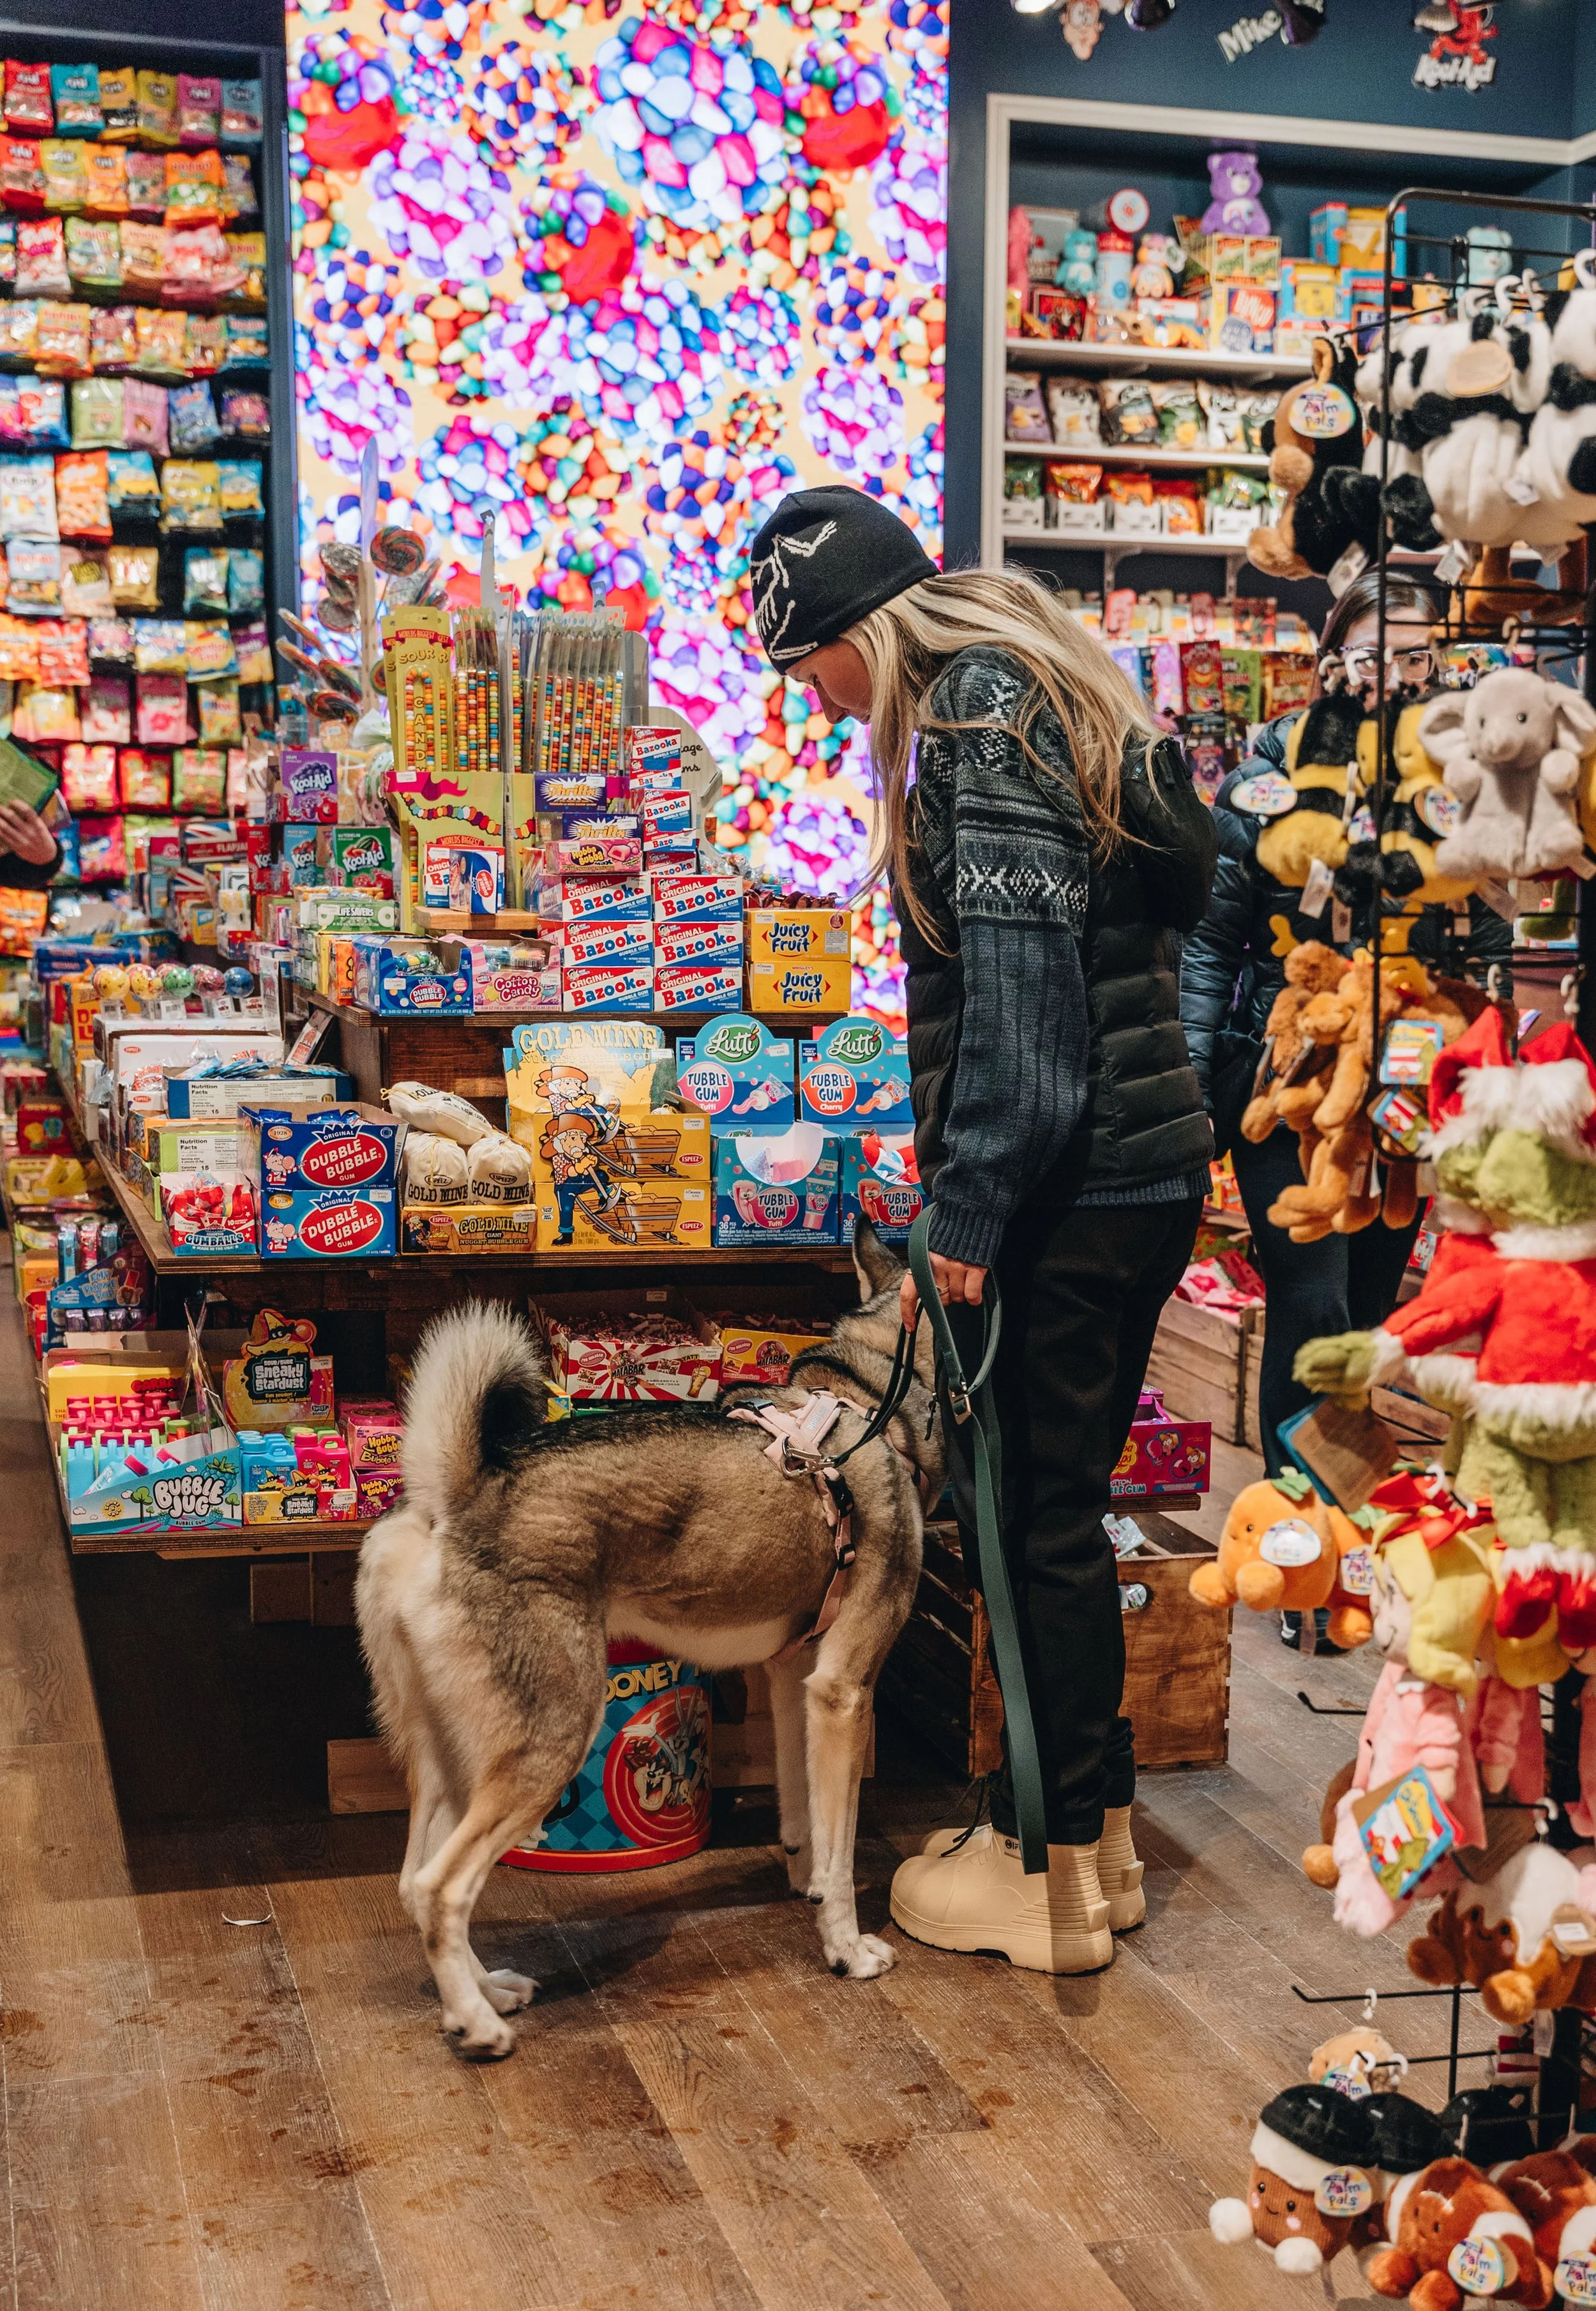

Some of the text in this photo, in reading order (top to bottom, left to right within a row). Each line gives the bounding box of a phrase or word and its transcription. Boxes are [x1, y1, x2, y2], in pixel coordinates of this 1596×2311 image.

[1218, 9, 1282, 64] Mike
[398, 629, 435, 639] WORLDS BIGGEST
[399, 649, 435, 665] SOUR
[634, 735, 658, 746] ORIGINAL
[636, 739, 678, 756] Bazooka
[290, 770, 332, 795] Kool-Aid
[547, 783, 596, 797] Thrifts
[645, 799, 686, 817] Bazooka
[576, 825, 626, 839] Thrifts
[342, 847, 385, 873] Kool-Aid
[578, 851, 604, 866] Bubba
[568, 880, 612, 898] ORIGINAL
[661, 881, 704, 900] ORIGINAL
[569, 885, 644, 915] Bazooka
[617, 901, 635, 910] BUBBLE
[662, 885, 736, 917] Bazooka
[709, 899, 739, 912] BUBBLE GUM
[570, 925, 614, 944] ORIGINAL
[661, 926, 704, 945] ORIGINAL
[769, 922, 811, 938] Juicy
[571, 931, 646, 961] Bazooka
[619, 944, 649, 957] BUBBLE GUM
[662, 931, 736, 962] Bazooka
[771, 937, 811, 953] Fruit
[709, 949, 726, 958] BUBBLE
[494, 975, 538, 991] Cotton
[569, 971, 614, 990] ORIGINAL
[660, 972, 704, 990] ORIGINAL
[780, 972, 823, 988] Juicy
[412, 986, 442, 998] DUBBLE
[414, 993, 444, 1004] BUBBLE
[500, 985, 541, 1002] Candy
[571, 976, 646, 1007] Bazooka
[618, 993, 636, 1002] BUBBLE
[662, 977, 735, 1007] Bazooka
[708, 990, 738, 1002] BUBBLE GUM
[783, 988, 823, 1004] Fruit
[518, 1024, 659, 1054] GOLD MINE
[706, 1025, 757, 1058] Lutti
[828, 1027, 878, 1060] Lutti
[688, 1073, 728, 1086] TUBBLE
[810, 1074, 851, 1087] TUBBLE
[695, 1087, 720, 1101] GUM
[818, 1087, 843, 1103] GUM
[699, 1103, 717, 1111] Tutti
[820, 1104, 843, 1113] Cherry
[324, 1130, 355, 1140] ORIGINAL
[310, 1139, 362, 1171] DUBBLE
[326, 1147, 379, 1180] BUBBLE
[408, 1185, 468, 1203] GOLD MINE
[472, 1180, 530, 1201] GOLD MINE
[320, 1198, 351, 1208] ORIGINAL
[758, 1194, 794, 1207] TUBBLE
[883, 1193, 918, 1205] TUBBLE
[765, 1206, 787, 1218] GUM
[888, 1205, 910, 1217] GUM
[307, 1205, 359, 1238] DUBBLE
[324, 1213, 375, 1246] BUBBLE
[459, 1217, 529, 1234] GOLD MINE
[719, 1221, 728, 1230] 36
[843, 1219, 853, 1228] 36
[185, 1232, 244, 1246] GUMBALLS
[337, 1240, 353, 1248] GUM
[757, 1353, 790, 1368] MALABAR
[255, 1364, 304, 1380] Sneaky
[611, 1362, 646, 1380] MALABAR
[131, 1376, 183, 1394] GARBA
[255, 1378, 305, 1391] Stardust
[368, 1435, 396, 1448] Hubba
[360, 1452, 391, 1465] Bubble
[155, 1476, 225, 1510] BUBBLE
[361, 1480, 382, 1492] Hubba
[368, 1485, 388, 1497] Bubba
[1125, 1483, 1147, 1494] GUM
[169, 1494, 209, 1518] JUG
[287, 1499, 314, 1509] Sneaky
[287, 1507, 314, 1515] Stardust
[1334, 2079, 1362, 2095] Palm
[1327, 2180, 1361, 2194] Palm
[1329, 2194, 1358, 2208] Pals
[1460, 2248, 1490, 2270] Palm
[1460, 2262, 1486, 2284] Pals
